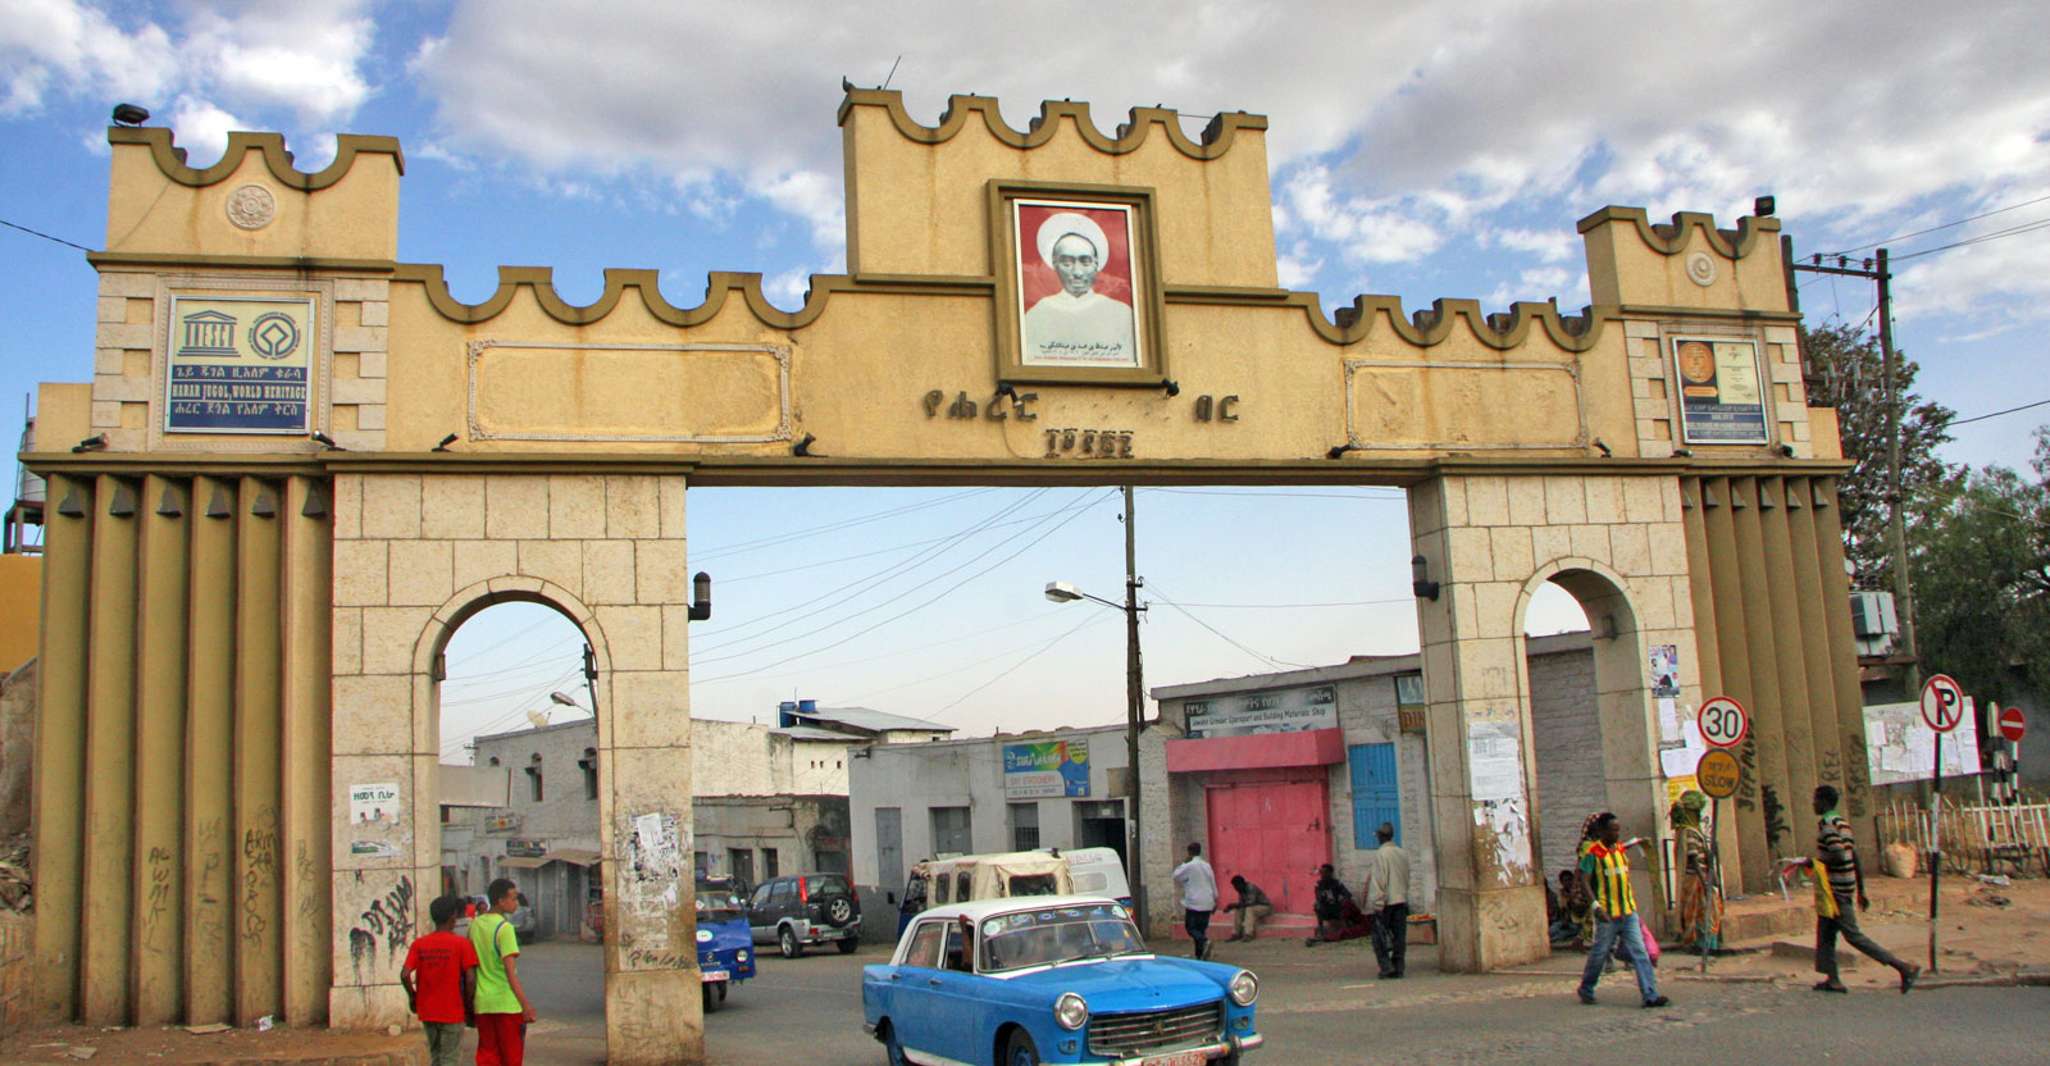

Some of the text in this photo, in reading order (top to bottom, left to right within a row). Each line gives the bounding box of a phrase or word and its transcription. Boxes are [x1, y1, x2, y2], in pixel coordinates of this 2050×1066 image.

[172, 383, 201, 398] HARAR
[263, 385, 306, 400] HERITAGE
[1706, 707, 1738, 739] 30
